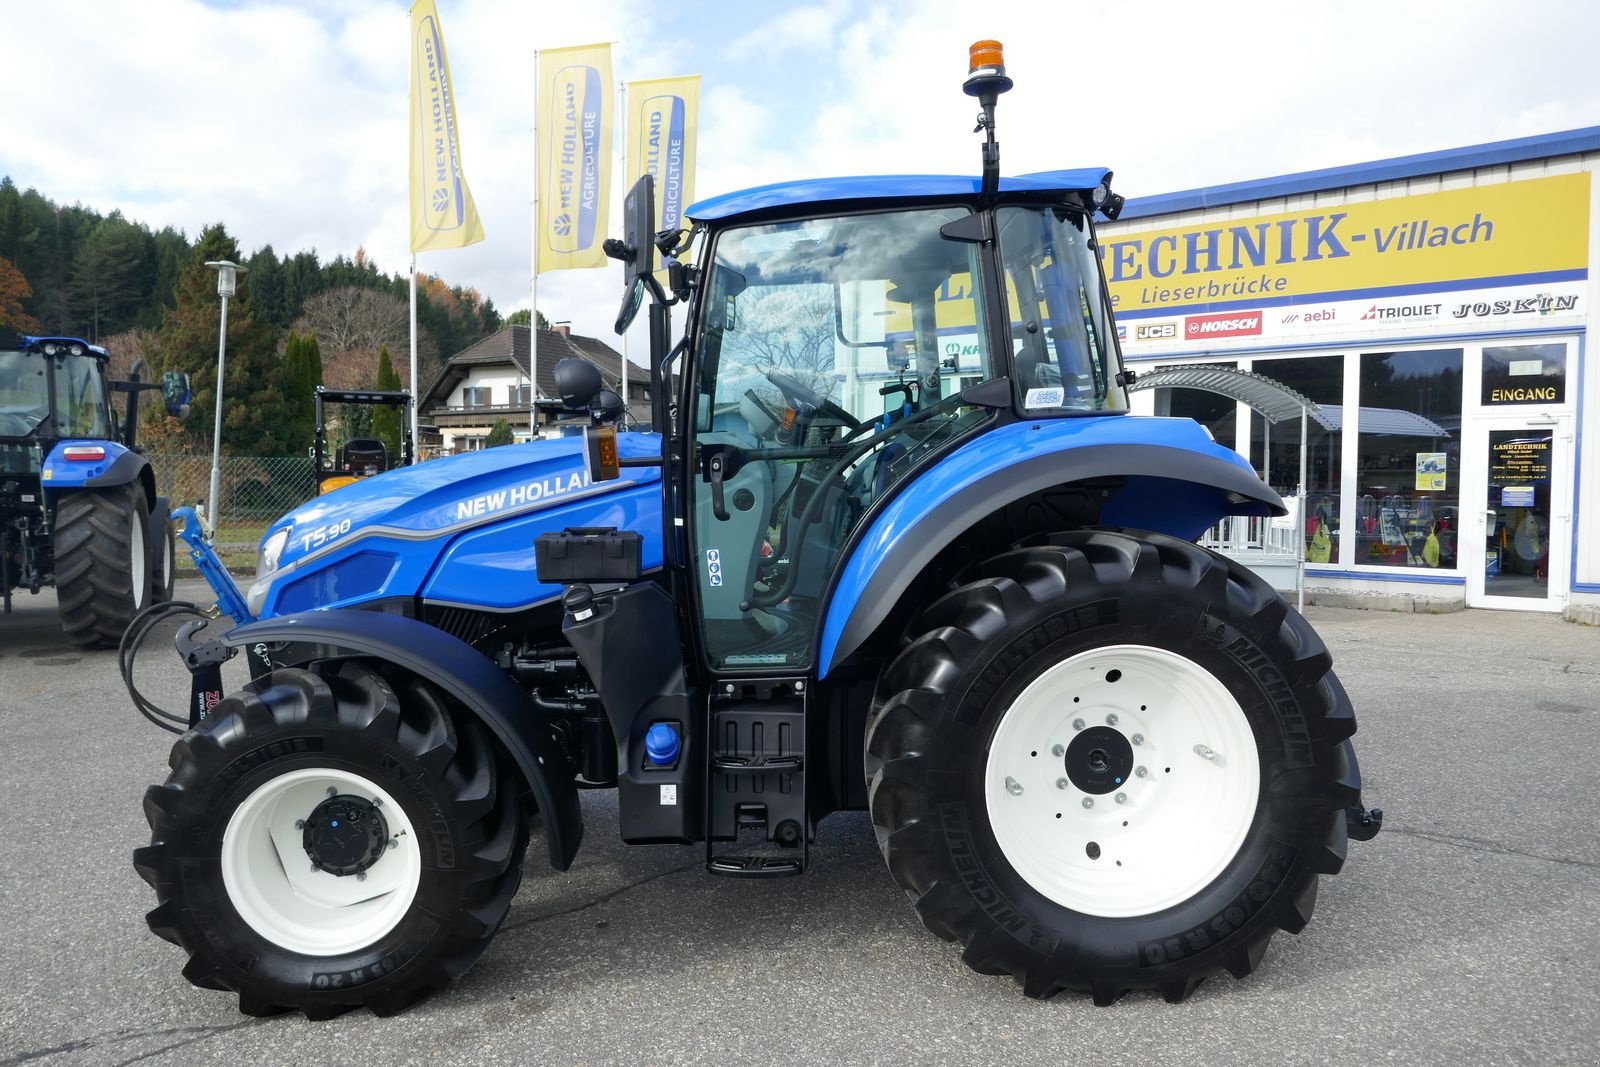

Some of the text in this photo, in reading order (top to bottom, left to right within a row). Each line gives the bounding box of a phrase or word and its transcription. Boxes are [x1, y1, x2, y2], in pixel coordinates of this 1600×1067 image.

[425, 38, 447, 182] NEW HOLLAND
[560, 82, 577, 209] NEW HOLLAND
[582, 111, 596, 210] AGRICULTURE
[665, 139, 681, 230] AGRICULTURE
[1141, 274, 1288, 304] Lieserbrücke
[1304, 308, 1336, 322] aebi
[1377, 304, 1442, 319] TRIOLIET
[1452, 295, 1579, 319] JOSKIN
[1138, 325, 1175, 339] JCB
[1200, 317, 1259, 333] HORSCH
[1491, 387, 1556, 401] EINGANG
[457, 491, 507, 520] NEW
[302, 519, 351, 551] T5.90
[1232, 636, 1312, 766] MICHELIN
[941, 803, 1035, 941] MICHELIN
[1144, 938, 1184, 964] 30
[315, 973, 343, 989] 20
